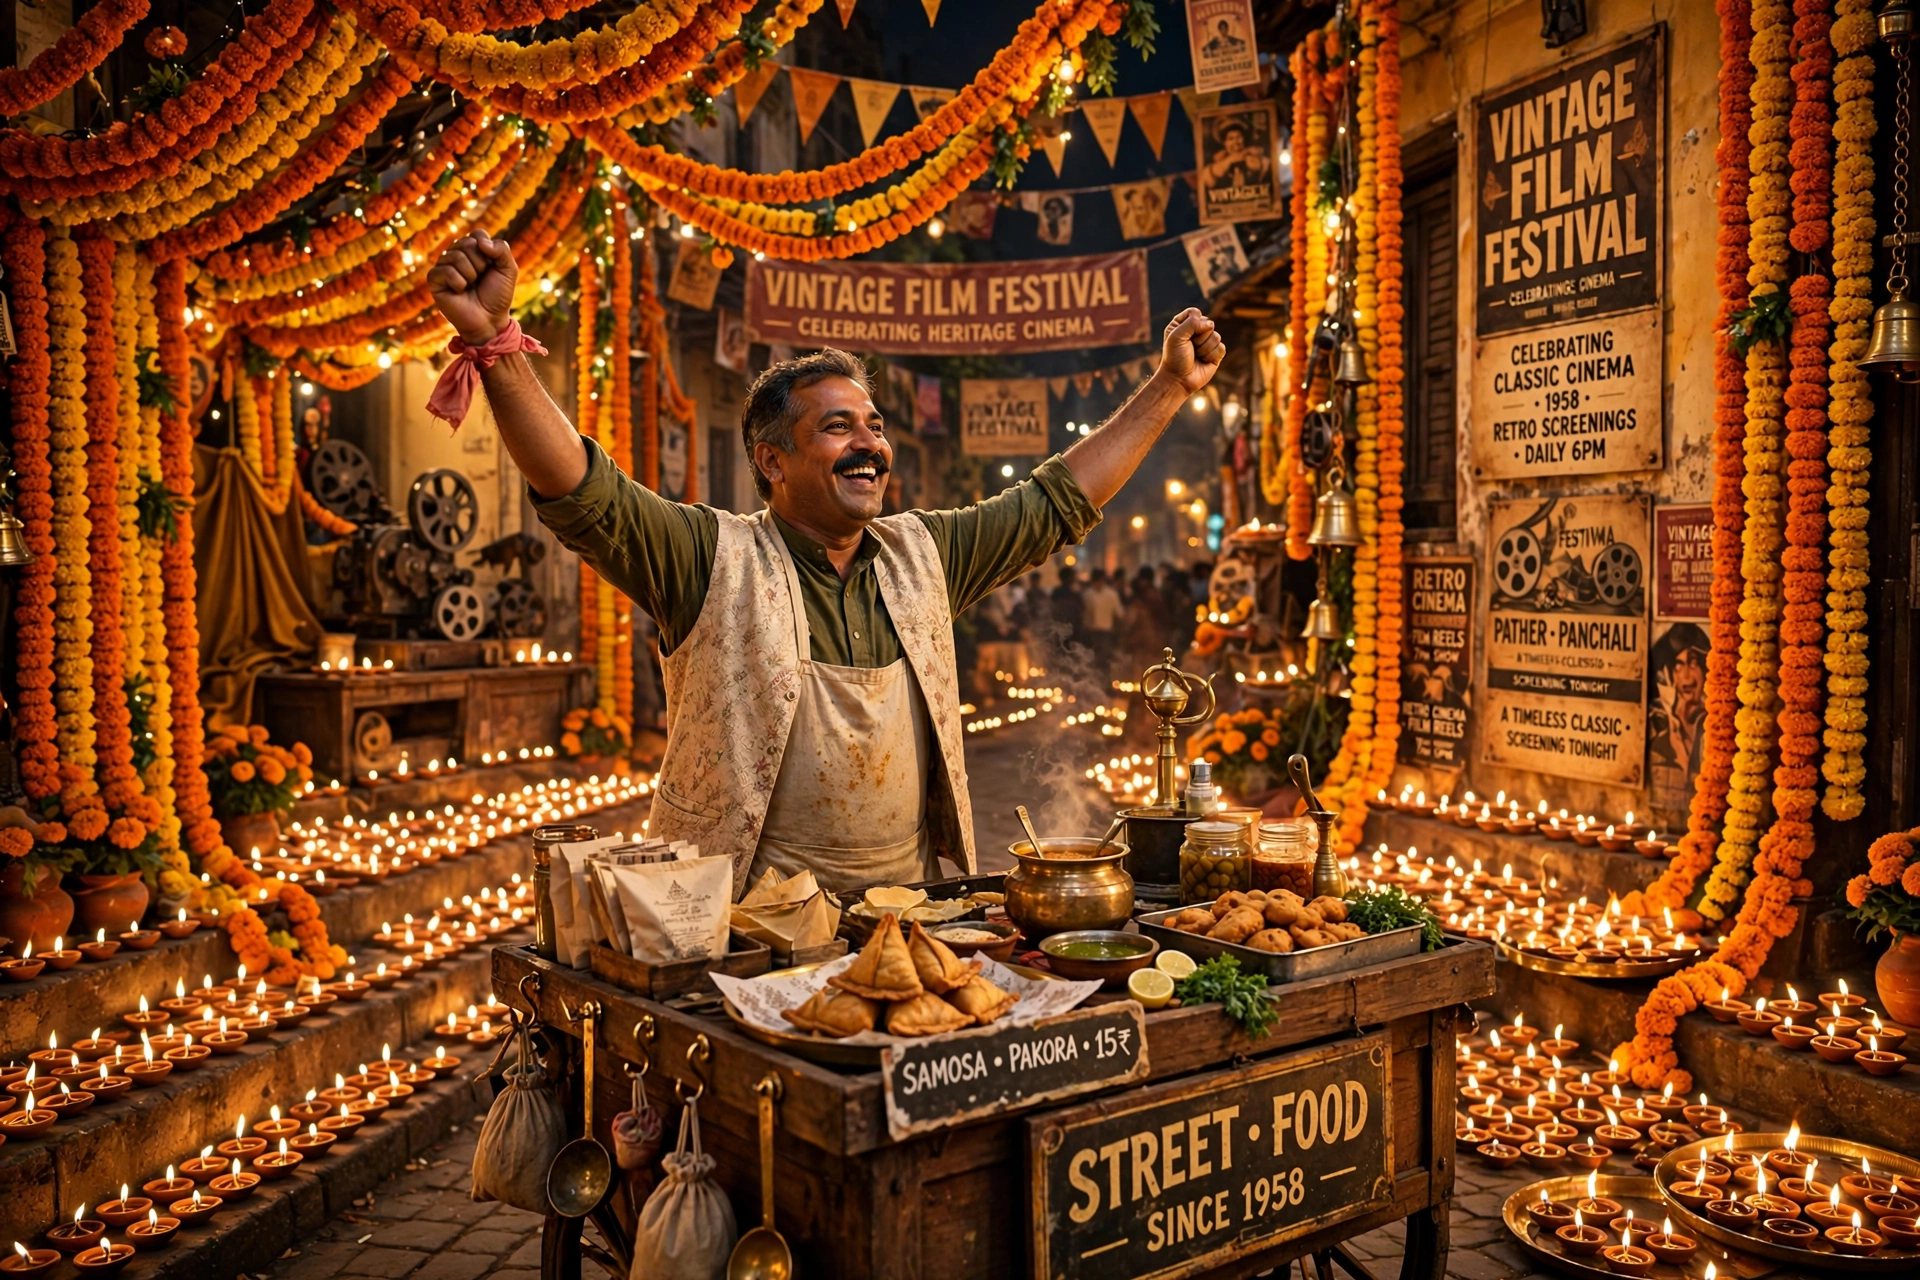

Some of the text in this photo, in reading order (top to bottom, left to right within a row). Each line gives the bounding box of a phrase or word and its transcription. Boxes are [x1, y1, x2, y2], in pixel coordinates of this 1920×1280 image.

[1489, 58, 1636, 164] VINTAGE
[1511, 131, 1613, 222] FILM
[1484, 193, 1647, 288] FESTIVAL
[764, 267, 1130, 316] VINTAGE FILM FESTIVAL
[799, 316, 1095, 343] CELEBRATING HERITAGE CINEMA
[1511, 330, 1614, 366] CELEBRATING
[1494, 354, 1636, 395] CLASSIC CINEMA
[1545, 389, 1580, 413] 1958
[1493, 408, 1637, 442] RETRO SCREENINGS
[1525, 438, 1606, 465] DAILY 6PM
[1668, 543, 1714, 560] FILM FE
[1413, 568, 1466, 591] RETRO
[1412, 591, 1466, 613] CINEMA
[1494, 617, 1548, 647] PATHER
[1559, 620, 1637, 652] PANCHALI
[1501, 706, 1622, 736] A TIMELESS CLASSIC
[1507, 730, 1619, 761] SCREENING TONIGHT
[902, 1027, 1132, 1096] SAMOSA PAKORA 15₹
[1068, 1080, 1369, 1224] STREET FOOD
[1147, 1167, 1305, 1253] SINCE 1958
